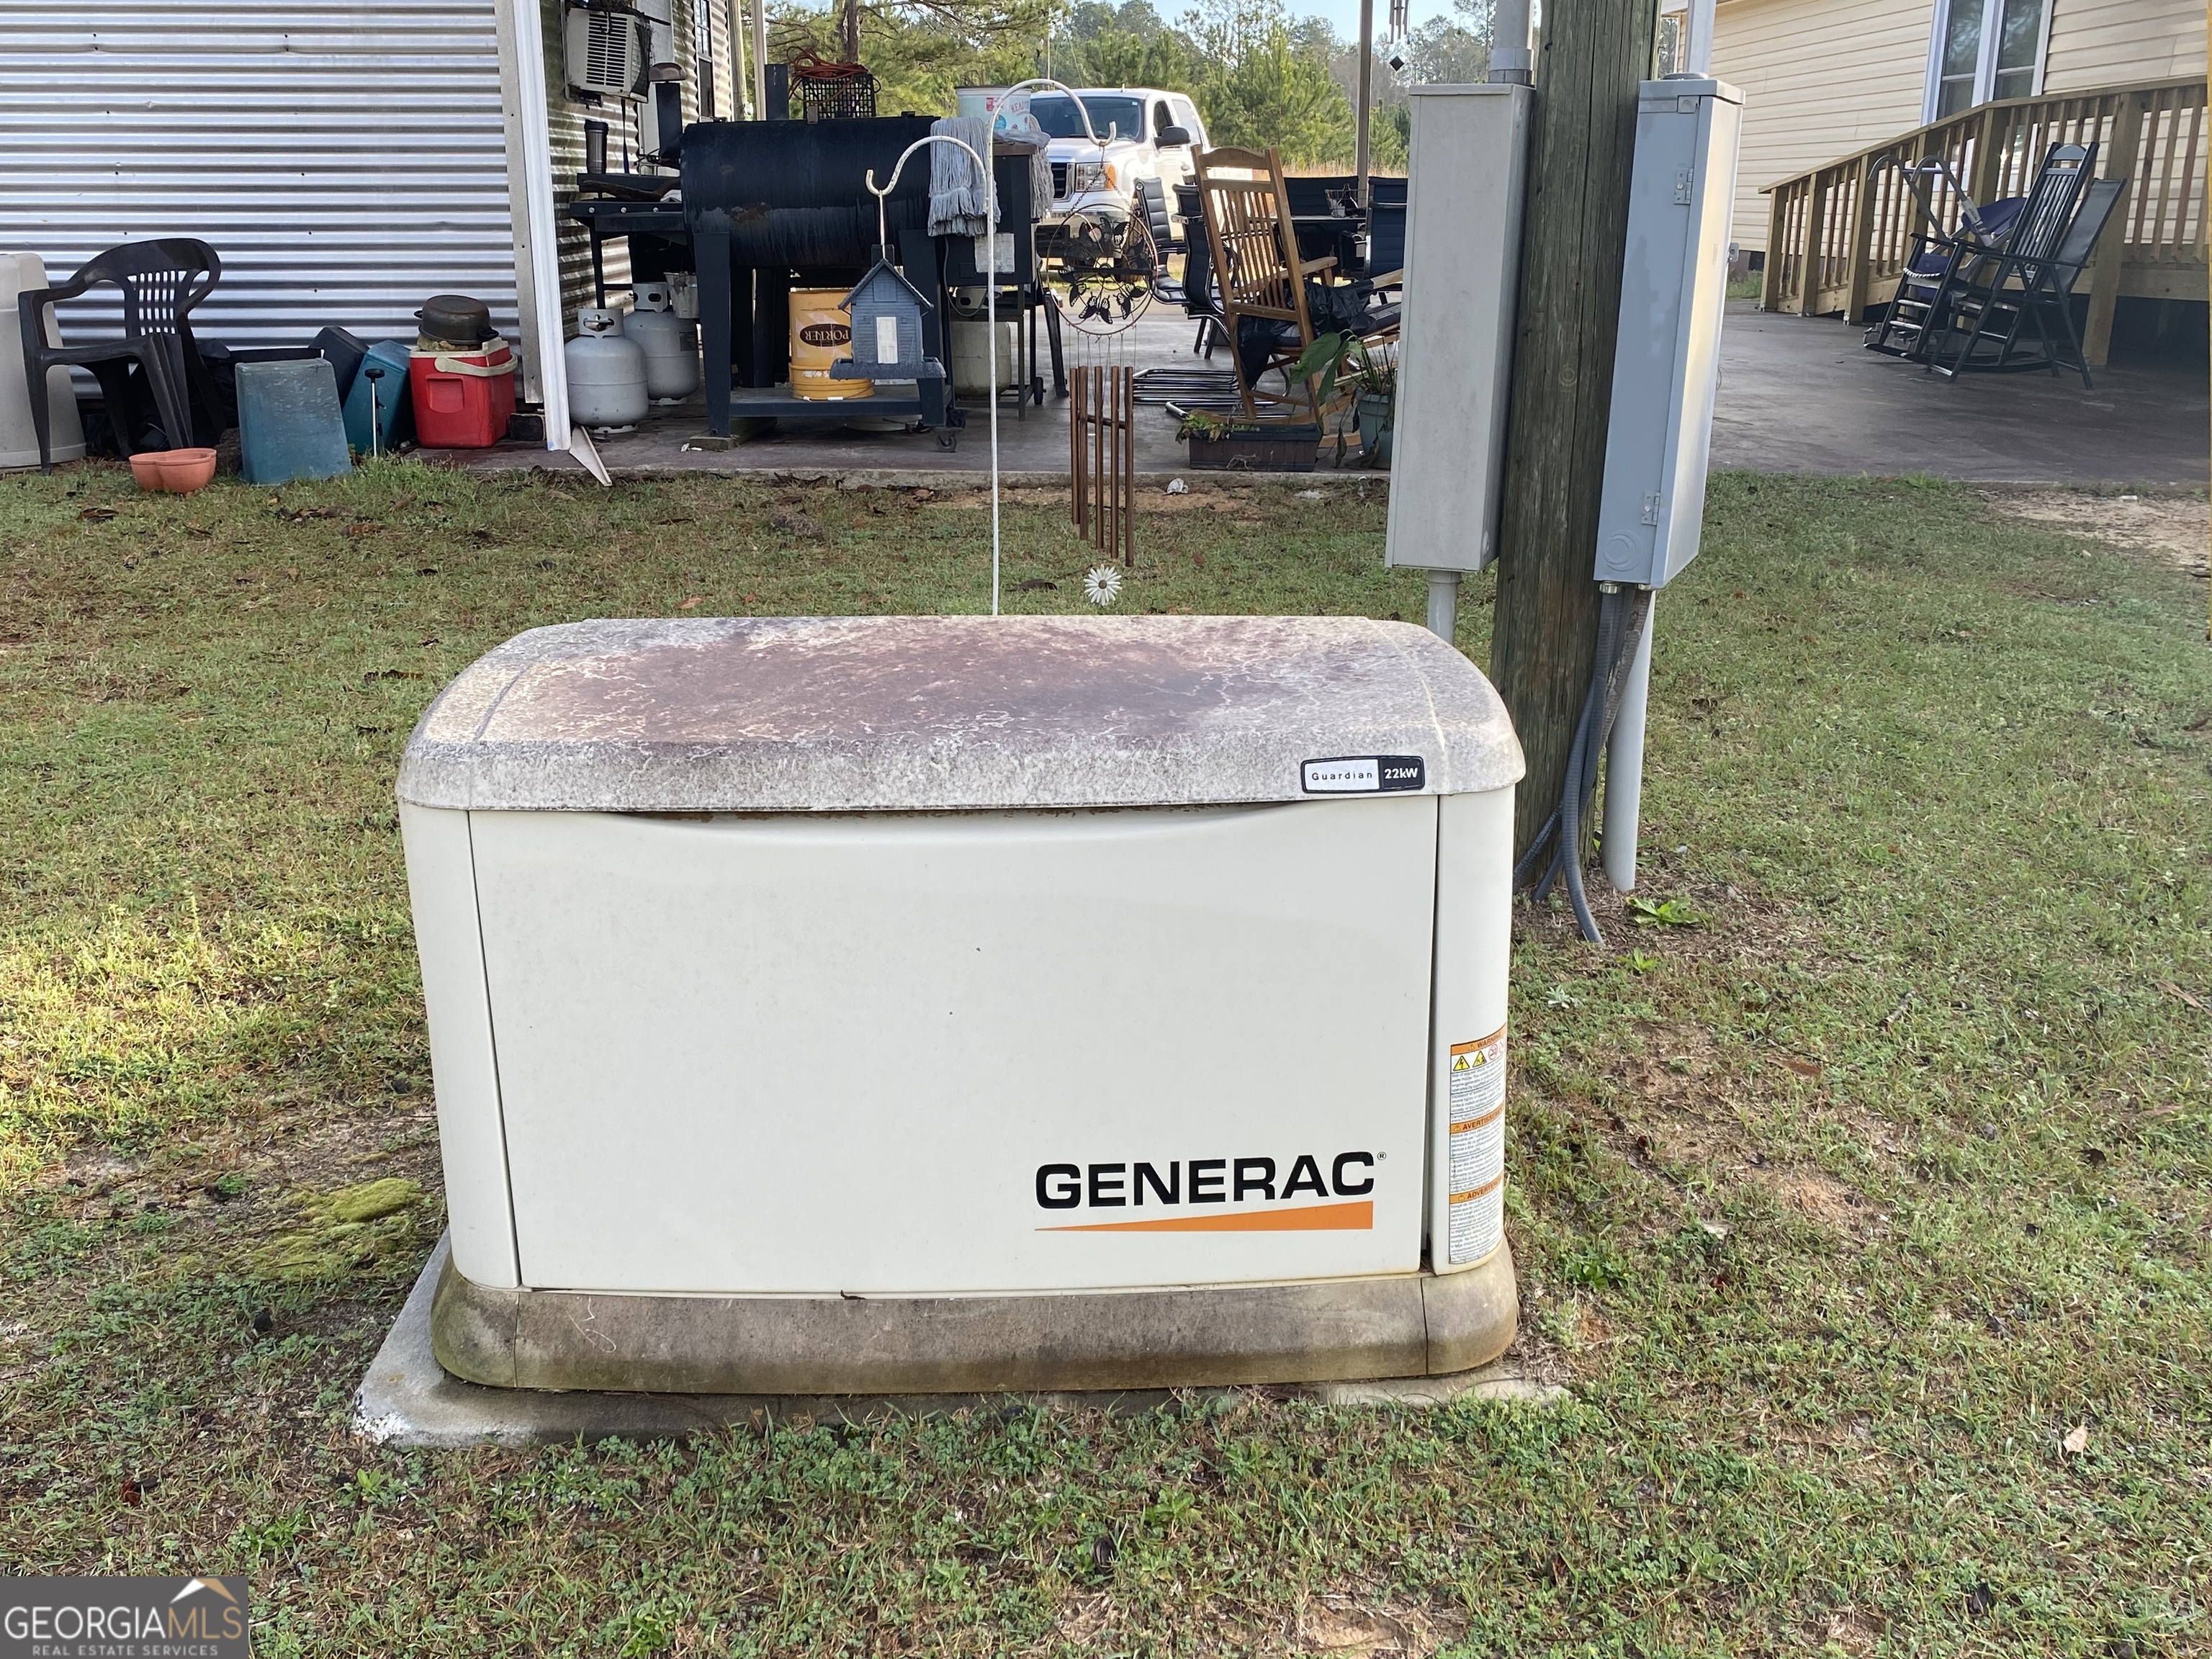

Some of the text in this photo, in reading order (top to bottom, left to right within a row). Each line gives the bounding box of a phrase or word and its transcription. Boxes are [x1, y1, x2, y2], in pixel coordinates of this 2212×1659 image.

[805, 330, 849, 341] PORTER
[1311, 767, 1419, 781] Guardian 22kW
[1477, 1032, 1501, 1048] WARNING
[1462, 1107, 1503, 1130] AVERTISSE
[1467, 1176, 1502, 1200] ADVERTEN
